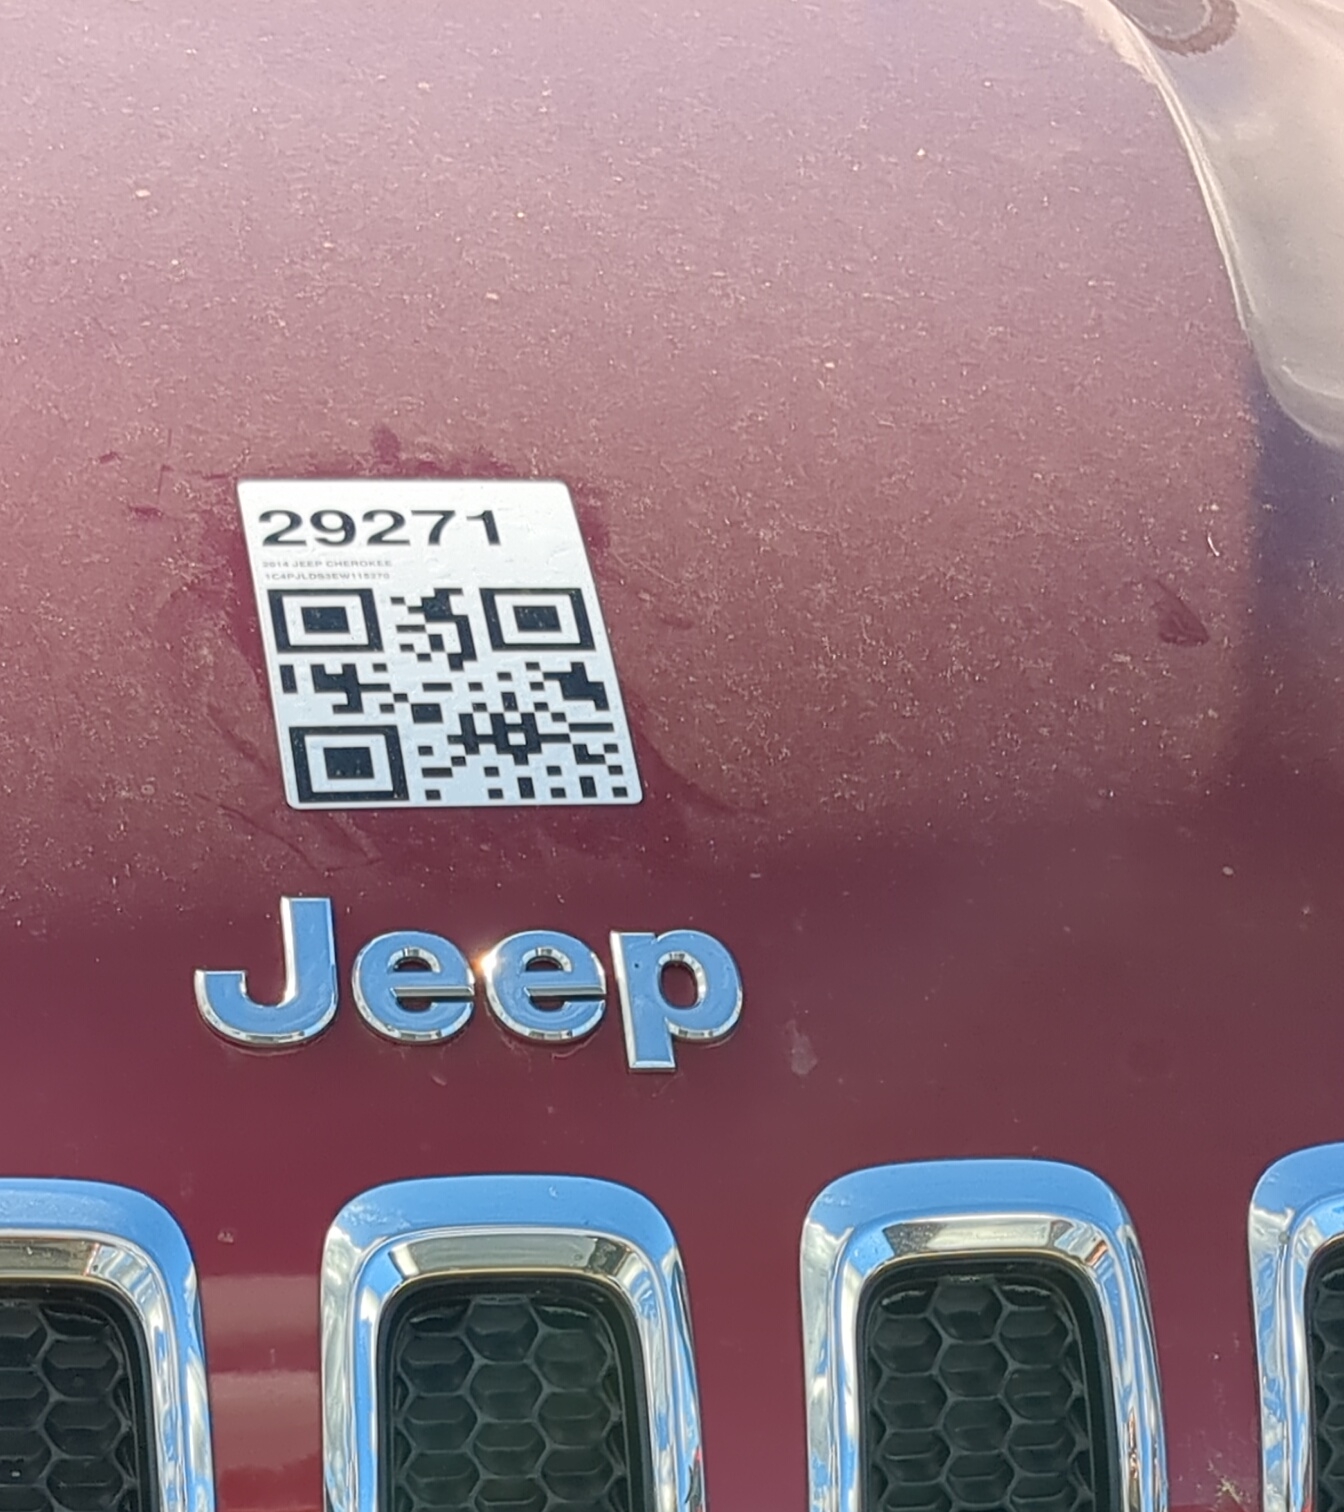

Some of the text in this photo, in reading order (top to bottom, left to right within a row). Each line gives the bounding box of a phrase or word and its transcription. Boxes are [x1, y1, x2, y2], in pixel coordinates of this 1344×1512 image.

[258, 509, 501, 546] 29271
[262, 559, 393, 569] 2014 JEEP CHEROKEE
[194, 895, 743, 1072] Jeep
